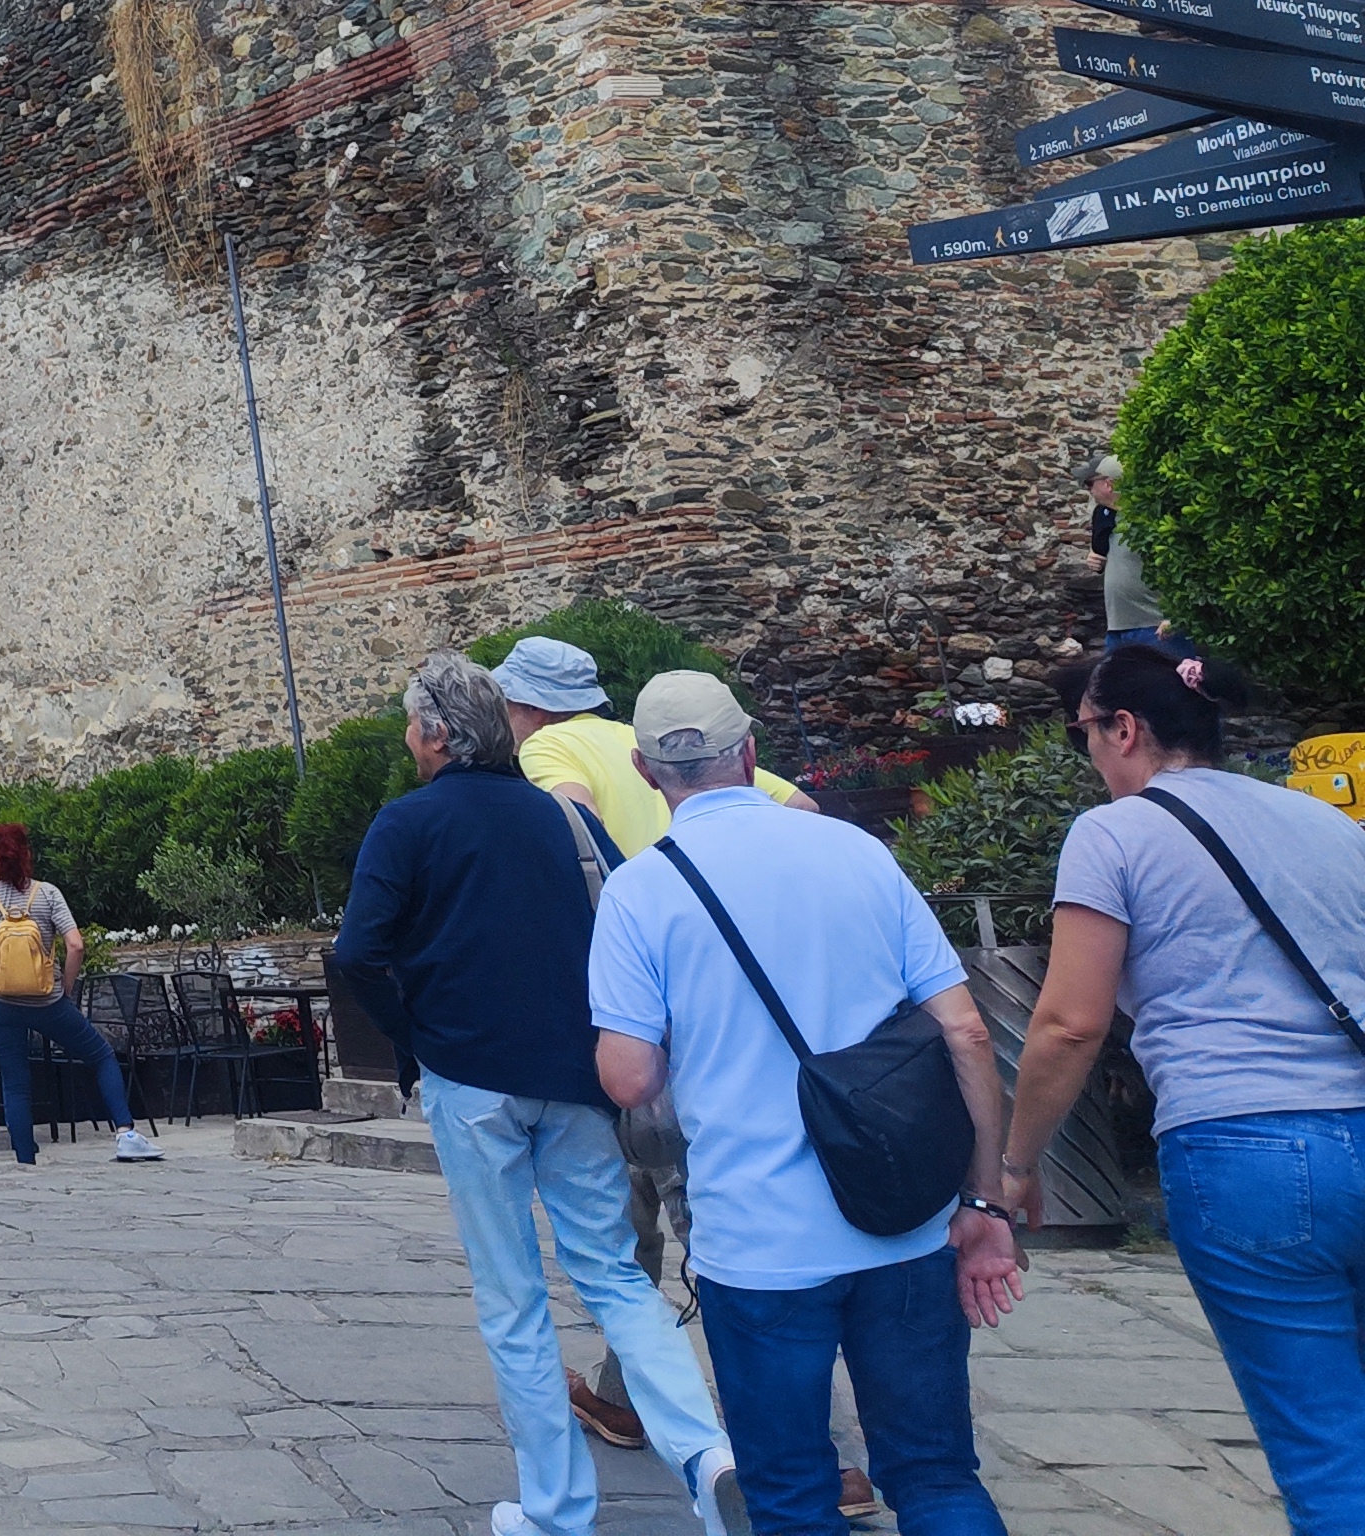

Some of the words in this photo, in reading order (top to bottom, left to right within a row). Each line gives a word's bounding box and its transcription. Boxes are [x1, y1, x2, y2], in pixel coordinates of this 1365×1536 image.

[1306, 1, 1361, 29] Πύργος
[1303, 23, 1333, 39] White
[1333, 27, 1363, 44] Tower
[1106, 108, 1148, 134] 145kcal
[1196, 128, 1236, 154] Μονή
[1236, 121, 1272, 141] Βλα
[1232, 138, 1279, 161] Vlatadon
[1152, 182, 1209, 204] Αγίου
[1215, 160, 1326, 191] Δημητρίου
[1175, 205, 1195, 219] St.
[1198, 192, 1273, 215] Demetriou
[1277, 180, 1331, 200] Church
